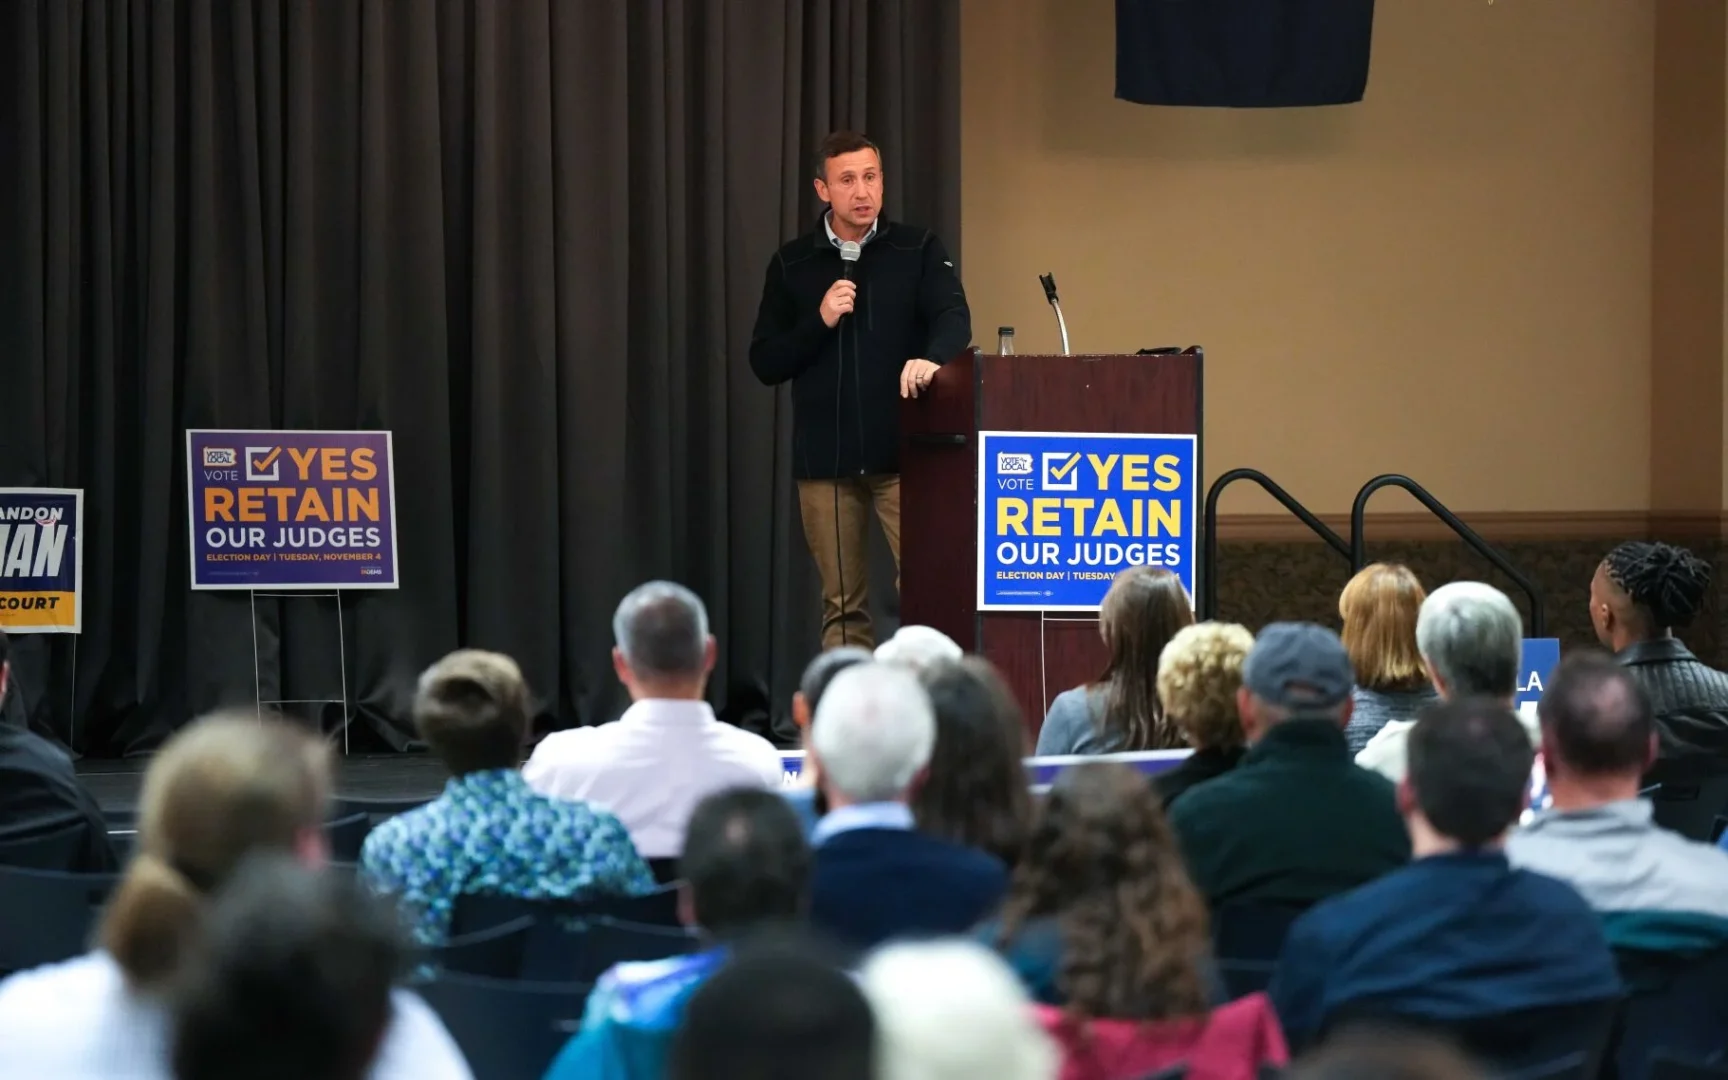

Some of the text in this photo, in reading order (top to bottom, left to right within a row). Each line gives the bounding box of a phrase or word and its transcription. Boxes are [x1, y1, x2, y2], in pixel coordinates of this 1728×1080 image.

[287, 447, 377, 480] YES
[1087, 454, 1181, 491] YES
[204, 470, 238, 481] VOTE
[997, 478, 1034, 491] VOTE
[205, 487, 380, 522] RETAIN
[997, 497, 1181, 537] RETAIN
[206, 527, 380, 548] OUR JUDGES
[207, 553, 250, 561] ELECTION
[997, 542, 1180, 566] OUR JUDGES
[1046, 572, 1064, 580] DAY
[0, 597, 60, 610] COURT
